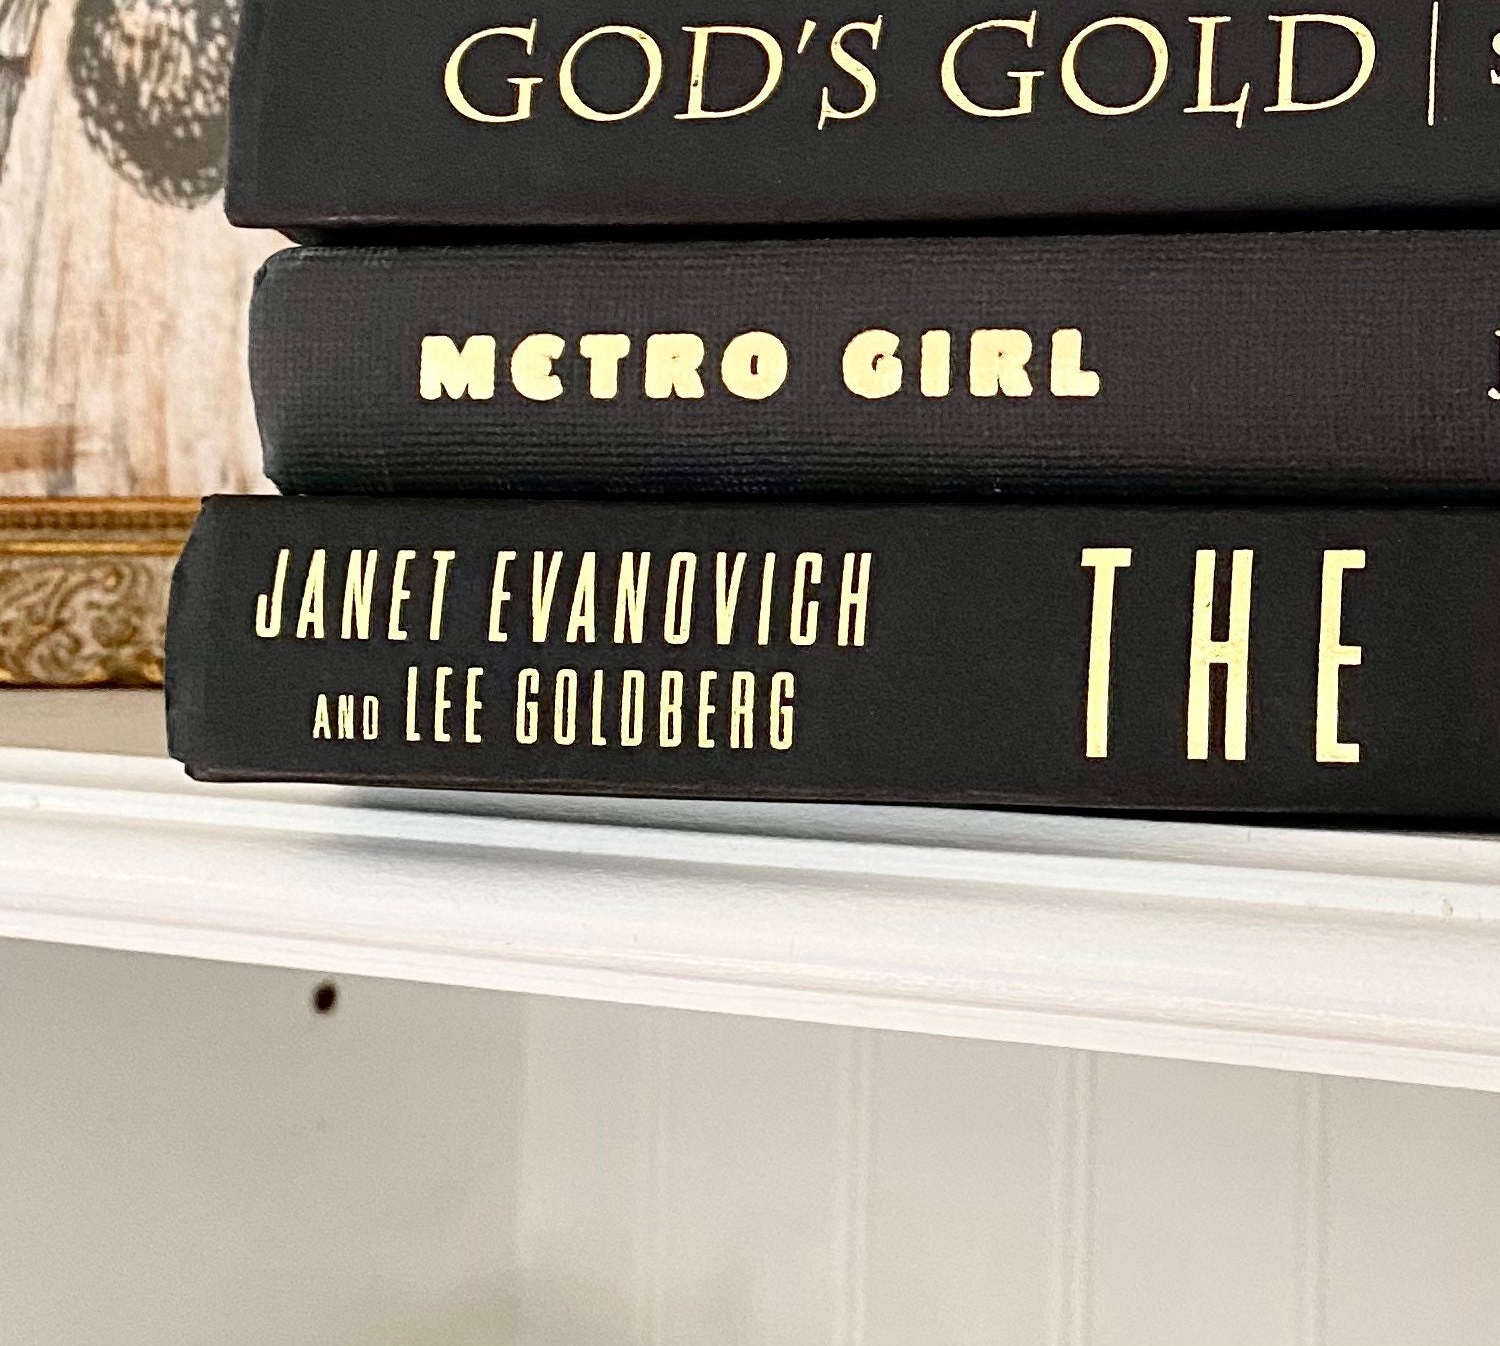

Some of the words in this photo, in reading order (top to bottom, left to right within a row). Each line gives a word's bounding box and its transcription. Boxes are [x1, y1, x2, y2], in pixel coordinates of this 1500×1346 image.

[444, 15, 883, 130] GOD'S
[941, 10, 1375, 128] GOLD
[420, 332, 788, 401] METRO
[842, 329, 1100, 399] GIRL
[256, 549, 455, 640] JANET
[488, 551, 872, 646] EVANOVICH
[1081, 548, 1365, 762] THE
[313, 694, 379, 740] AND
[406, 667, 483, 743] LEE
[516, 668, 794, 750] GOLDBERG
